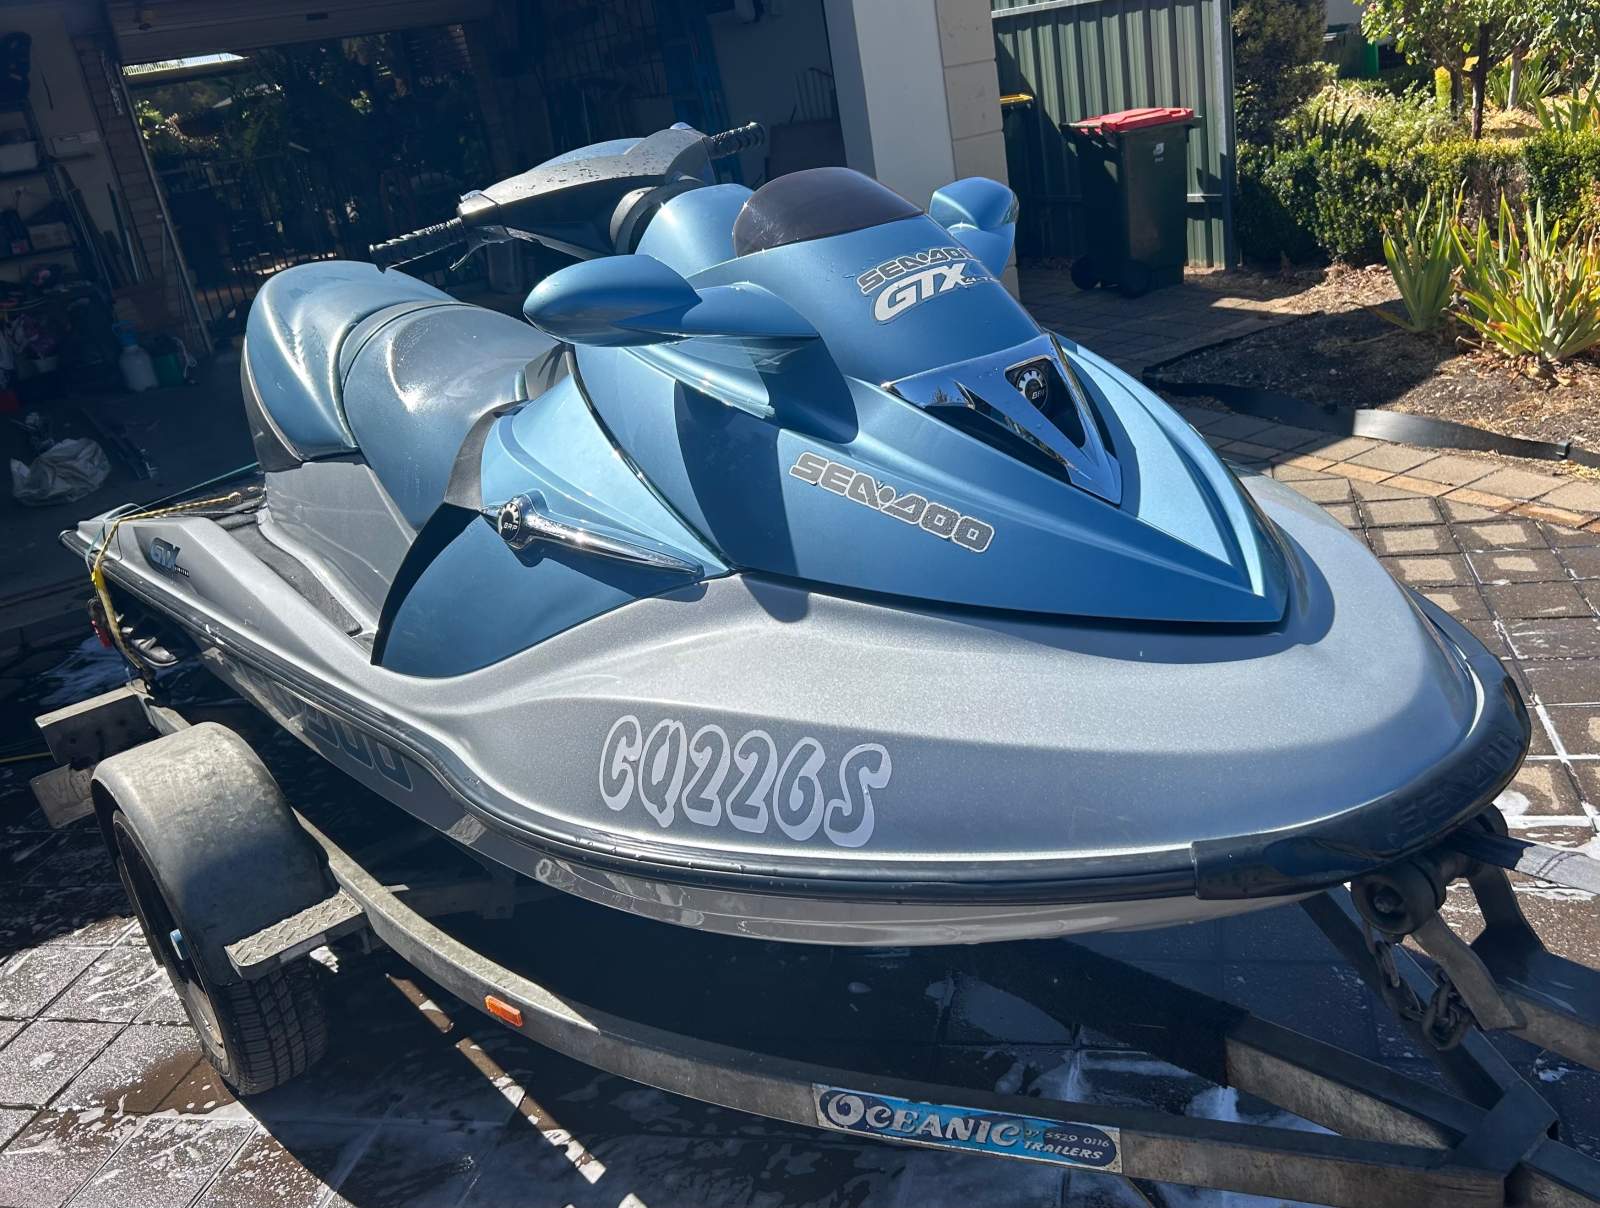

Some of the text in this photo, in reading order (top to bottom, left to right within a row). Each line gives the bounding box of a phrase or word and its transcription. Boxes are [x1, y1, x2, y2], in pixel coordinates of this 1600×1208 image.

[873, 263, 966, 322] GTX
[503, 522, 518, 530] BRP
[599, 715, 892, 848] CQ226S
[827, 1093, 1020, 1147] OCEANIC
[1024, 1141, 1103, 1159] TRAILERS
[1045, 1131, 1078, 1142] 5529
[1083, 1137, 1110, 1148] 0116
